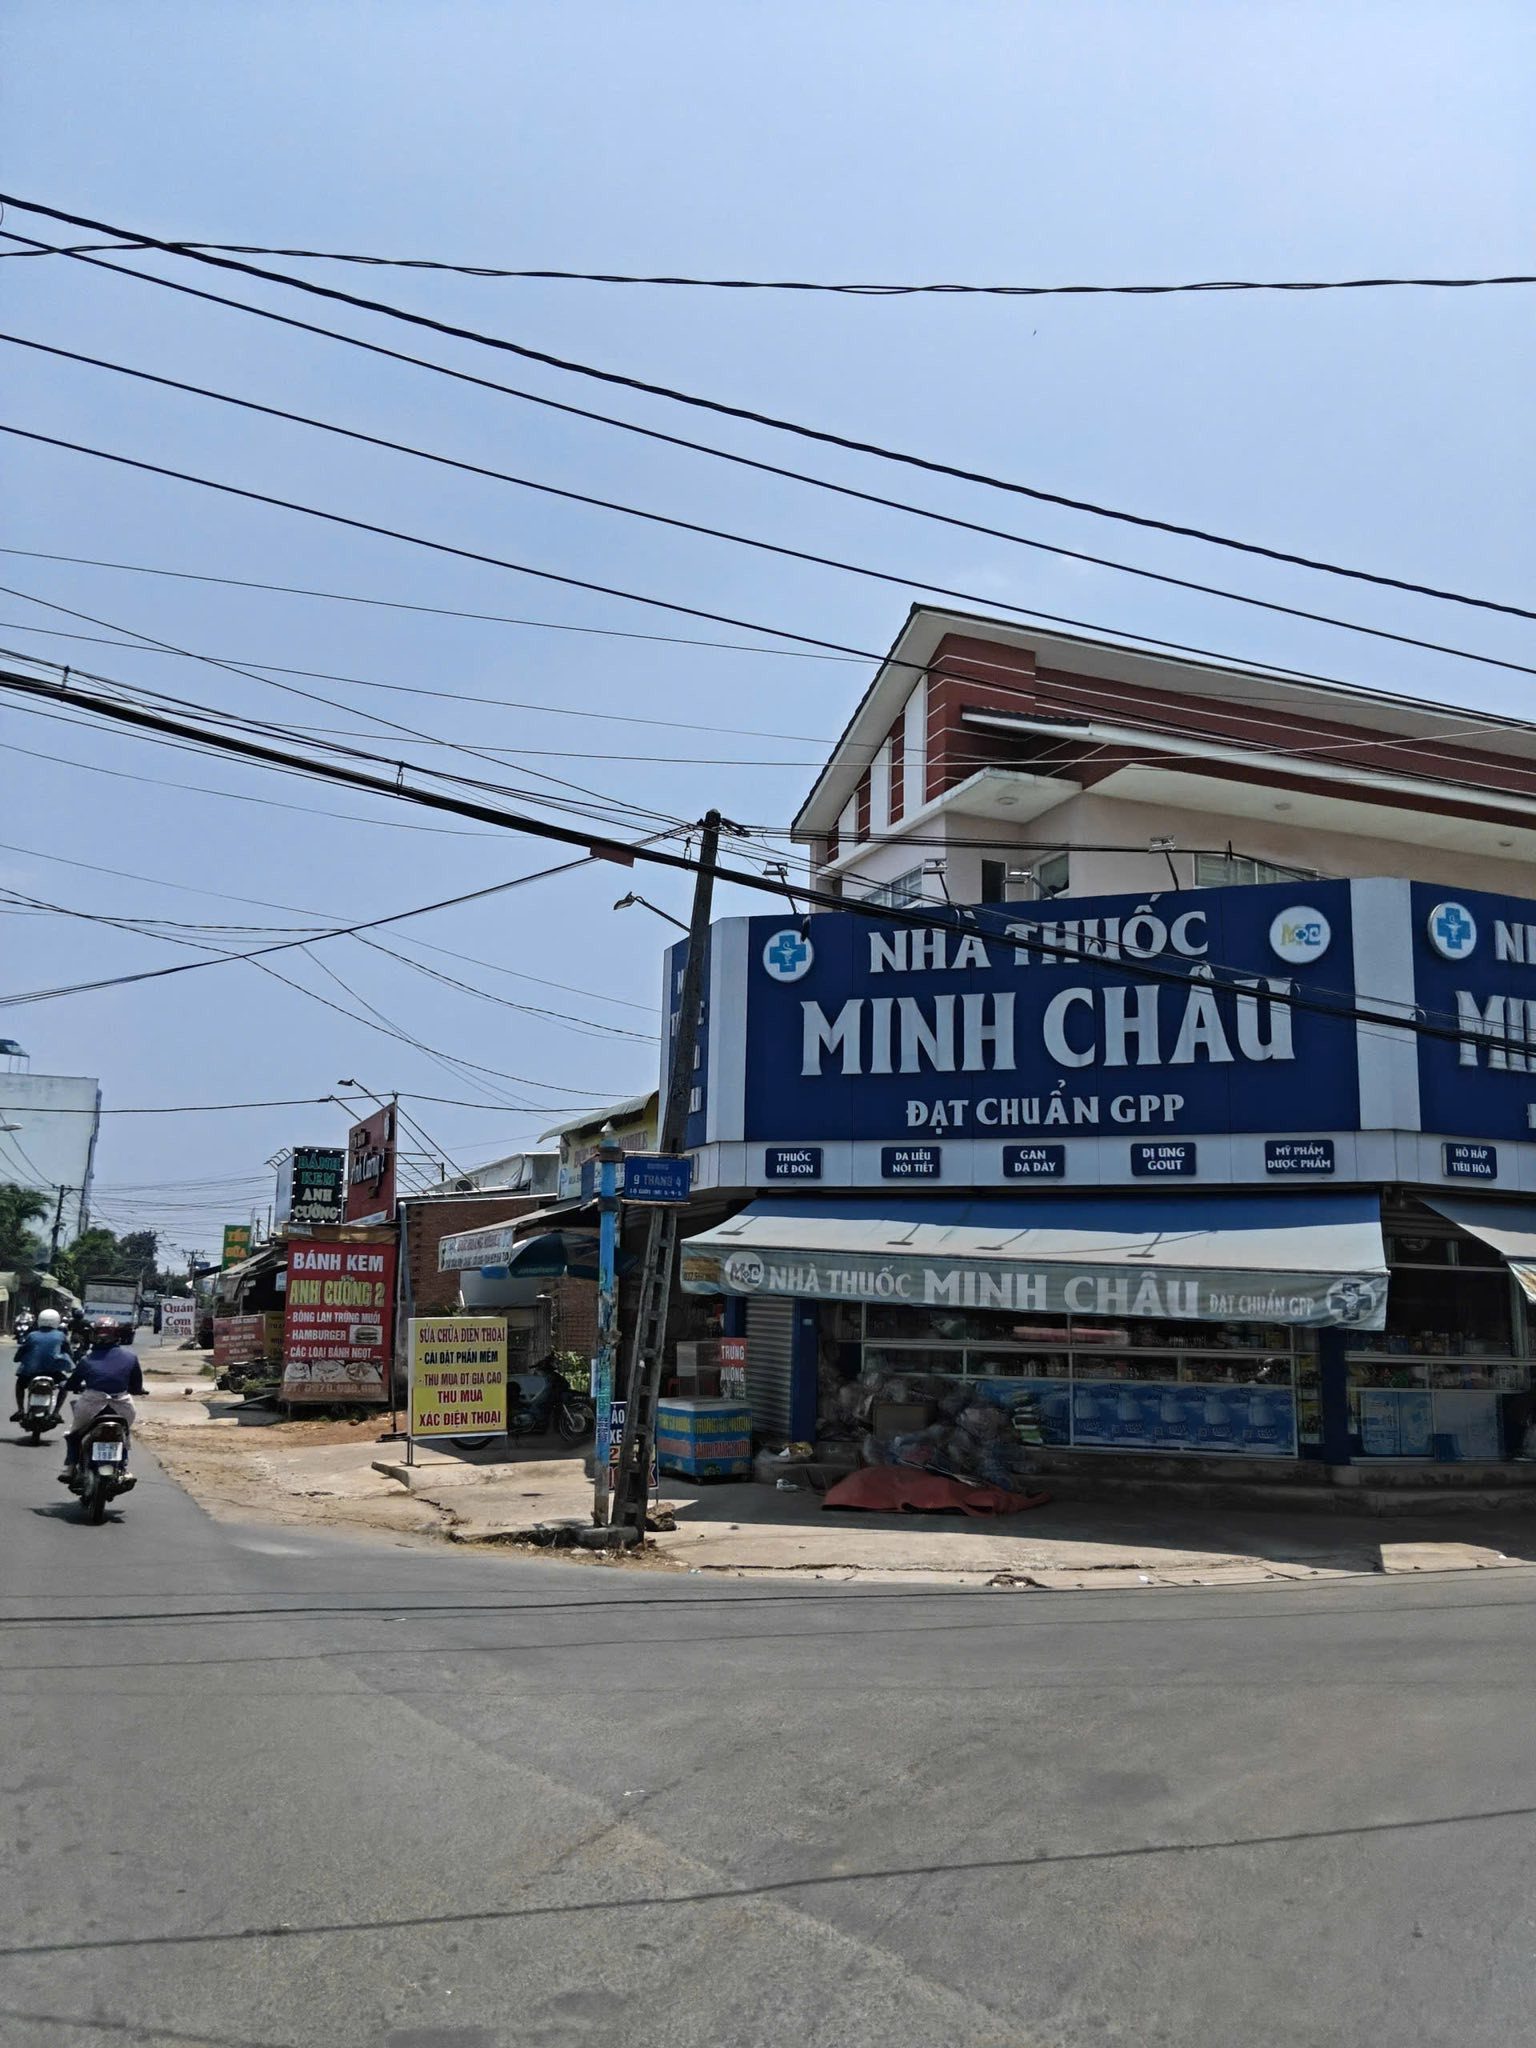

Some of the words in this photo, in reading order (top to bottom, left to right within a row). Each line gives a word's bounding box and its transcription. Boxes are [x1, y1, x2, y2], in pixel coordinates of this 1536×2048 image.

[868, 910, 992, 973] NHÀ
[1004, 893, 1209, 966] THUỐC
[800, 991, 1017, 1075] MINH
[1043, 963, 1295, 1068] CHÂU
[906, 1099, 969, 1134] ĐẠT
[976, 1079, 1099, 1126] CHUẨN
[1110, 1094, 1185, 1123] GPP
[895, 1152, 910, 1161] DA
[911, 1149, 931, 1161] LIỄU
[1020, 1150, 1046, 1160] GAN
[1142, 1148, 1154, 1160] DỊ
[1158, 1146, 1185, 1158] ỨNG
[1276, 1145, 1292, 1155] MỸ
[1294, 1141, 1323, 1155] PHẨM
[1455, 1147, 1469, 1158] HÔ
[1471, 1147, 1488, 1160] HẤP
[298, 1153, 341, 1171] BÁNH
[777, 1150, 811, 1162] THUỐC
[1267, 1159, 1298, 1171] DƯỢC
[1300, 1155, 1331, 1169] PHẨM
[776, 1163, 789, 1174] KÊ
[791, 1164, 814, 1174] ĐƠN
[893, 1163, 911, 1175] NỘI
[914, 1161, 934, 1173] TIẾT
[1014, 1162, 1030, 1174] DẠ
[1033, 1160, 1056, 1172] DÀY
[1147, 1160, 1183, 1170] GOUT
[1452, 1161, 1471, 1172] TIÊU
[1472, 1162, 1491, 1173] HÓA
[301, 1171, 336, 1186] KEM
[302, 1188, 333, 1202] ANH
[293, 1250, 341, 1271] BÁNH
[347, 1254, 384, 1272] KEM
[289, 1279, 321, 1305] ANH
[375, 1282, 385, 1307] 2
[769, 1262, 820, 1292] NHÀ
[827, 1264, 912, 1298] THUỐC
[922, 1268, 1048, 1312] MINH
[1063, 1271, 1199, 1318] CHÂU
[1209, 1293, 1235, 1314] ĐẠT
[1238, 1288, 1287, 1316] CHUẨN
[1288, 1297, 1314, 1317] GPP
[163, 1303, 193, 1314] Quán
[292, 1311, 315, 1323] BÔNG
[316, 1312, 332, 1322] LAN
[292, 1329, 346, 1341] HAMBURGER
[482, 1326, 505, 1344] THOẠI
[290, 1345, 306, 1357] CÁC
[308, 1347, 327, 1359] LOẠI
[328, 1346, 350, 1358] BÁNH
[351, 1348, 371, 1360] NGỌT
[424, 1373, 439, 1386] THU
[441, 1373, 458, 1386] MUA
[487, 1371, 502, 1384] CAO
[437, 1390, 457, 1403] THU
[460, 1389, 483, 1402] MUA
[419, 1408, 440, 1427] XÁC
[443, 1410, 468, 1428] ĐIỆN
[471, 1410, 501, 1426] THOẠI
